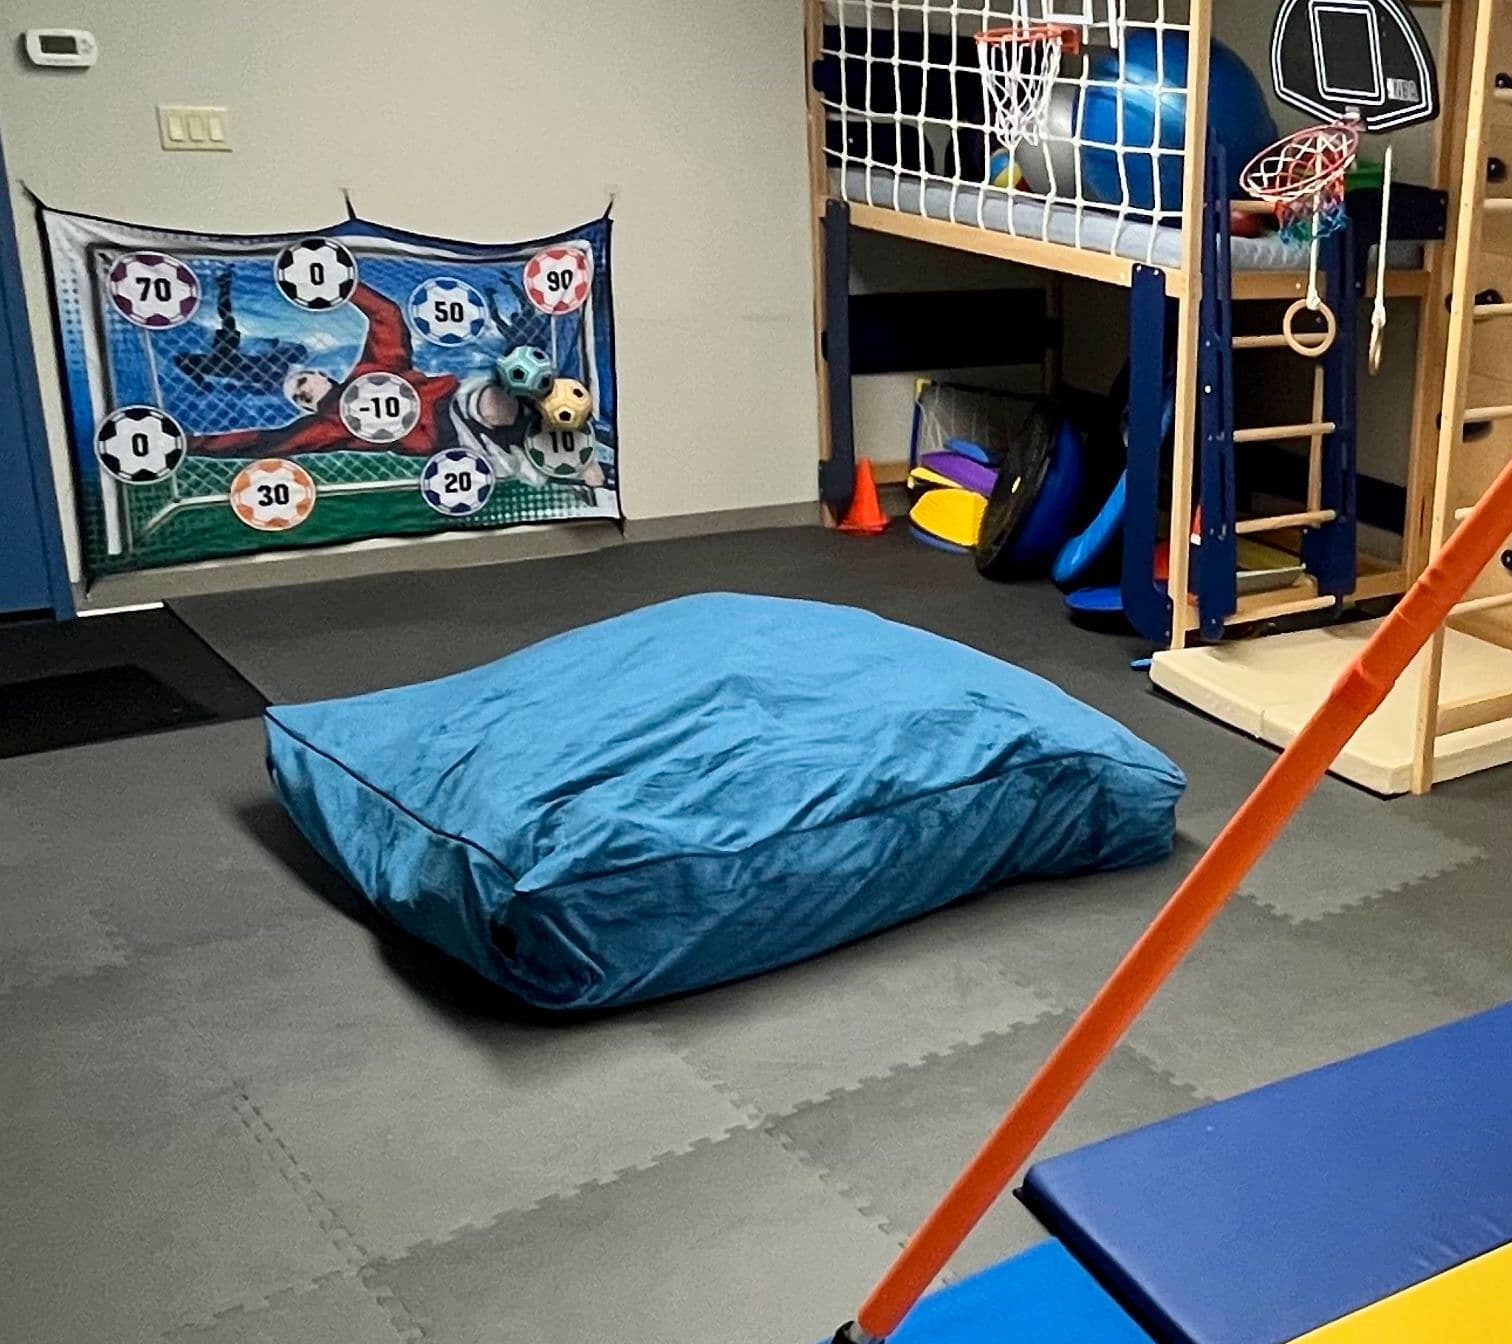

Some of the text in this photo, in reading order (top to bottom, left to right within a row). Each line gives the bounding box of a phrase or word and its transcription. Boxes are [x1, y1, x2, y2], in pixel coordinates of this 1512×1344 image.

[309, 262, 324, 286] 0
[547, 268, 574, 292] 90
[135, 277, 171, 302] 70
[434, 300, 464, 324] 50
[359, 396, 401, 419] -10
[133, 433, 150, 458] 0
[445, 471, 472, 494] 20
[258, 484, 289, 507] 30
